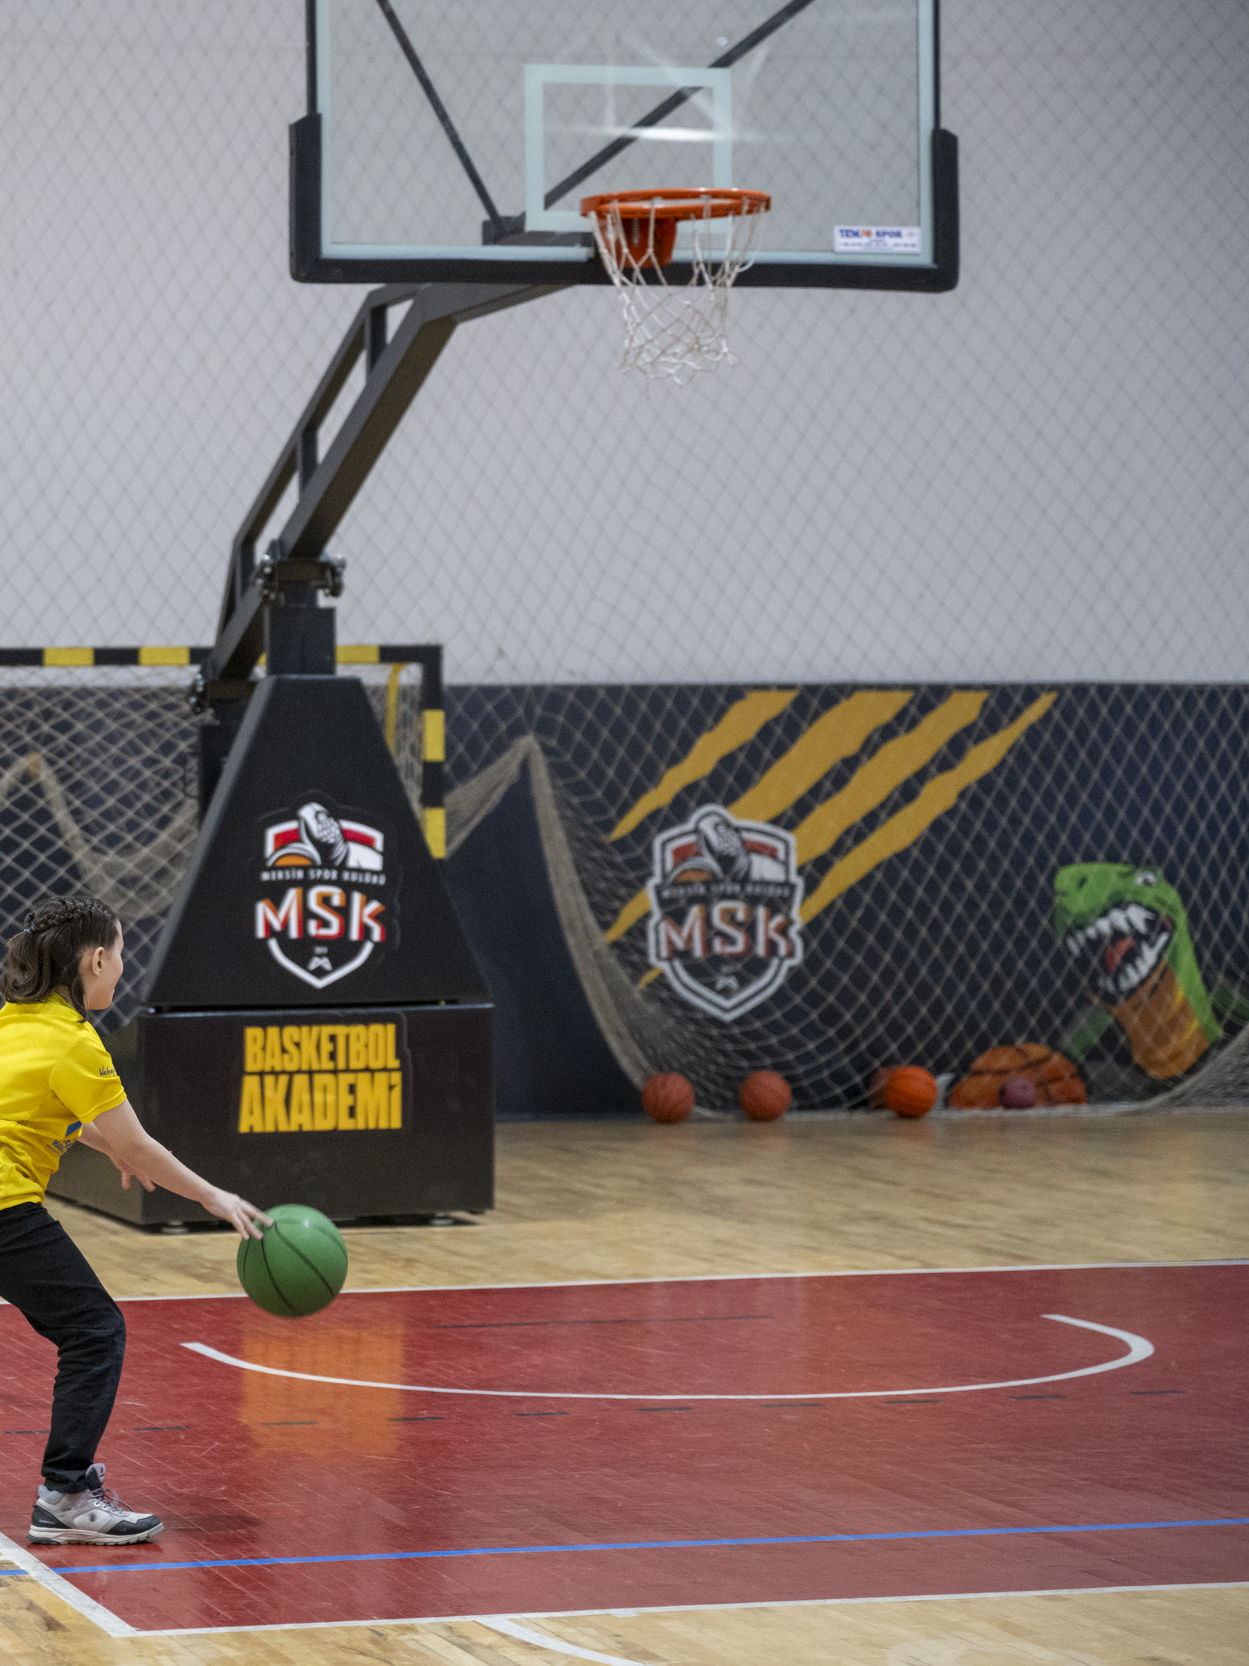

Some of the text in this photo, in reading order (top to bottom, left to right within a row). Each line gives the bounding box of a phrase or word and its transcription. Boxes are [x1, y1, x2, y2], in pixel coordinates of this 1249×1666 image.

[255, 885, 386, 942] MSK
[658, 901, 793, 957] MSK
[244, 1023, 400, 1073] BASKETBOL
